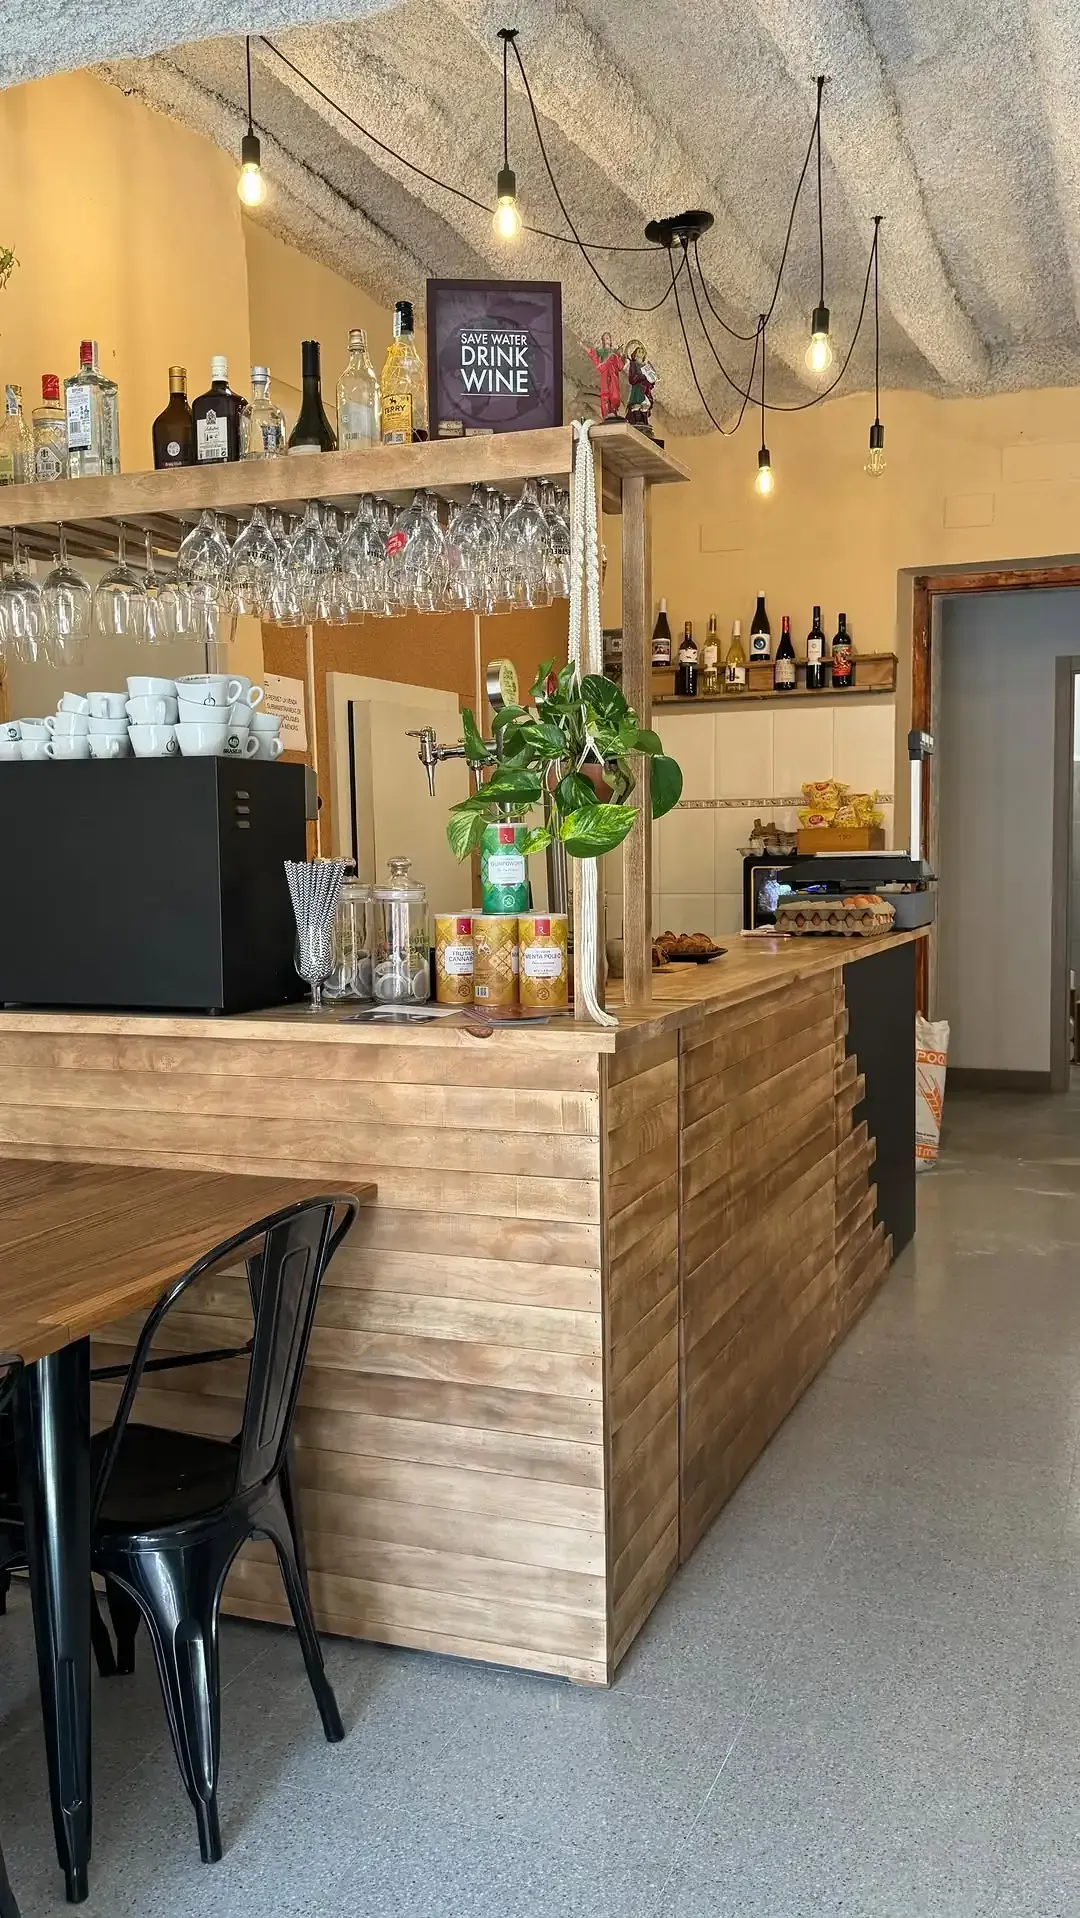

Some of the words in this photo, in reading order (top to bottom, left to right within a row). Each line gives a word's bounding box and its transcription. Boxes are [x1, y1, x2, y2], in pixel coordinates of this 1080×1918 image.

[461, 333, 488, 345] SAVE
[491, 334, 528, 346] WATER
[461, 345, 529, 367] DRINK
[460, 368, 529, 393] WINE
